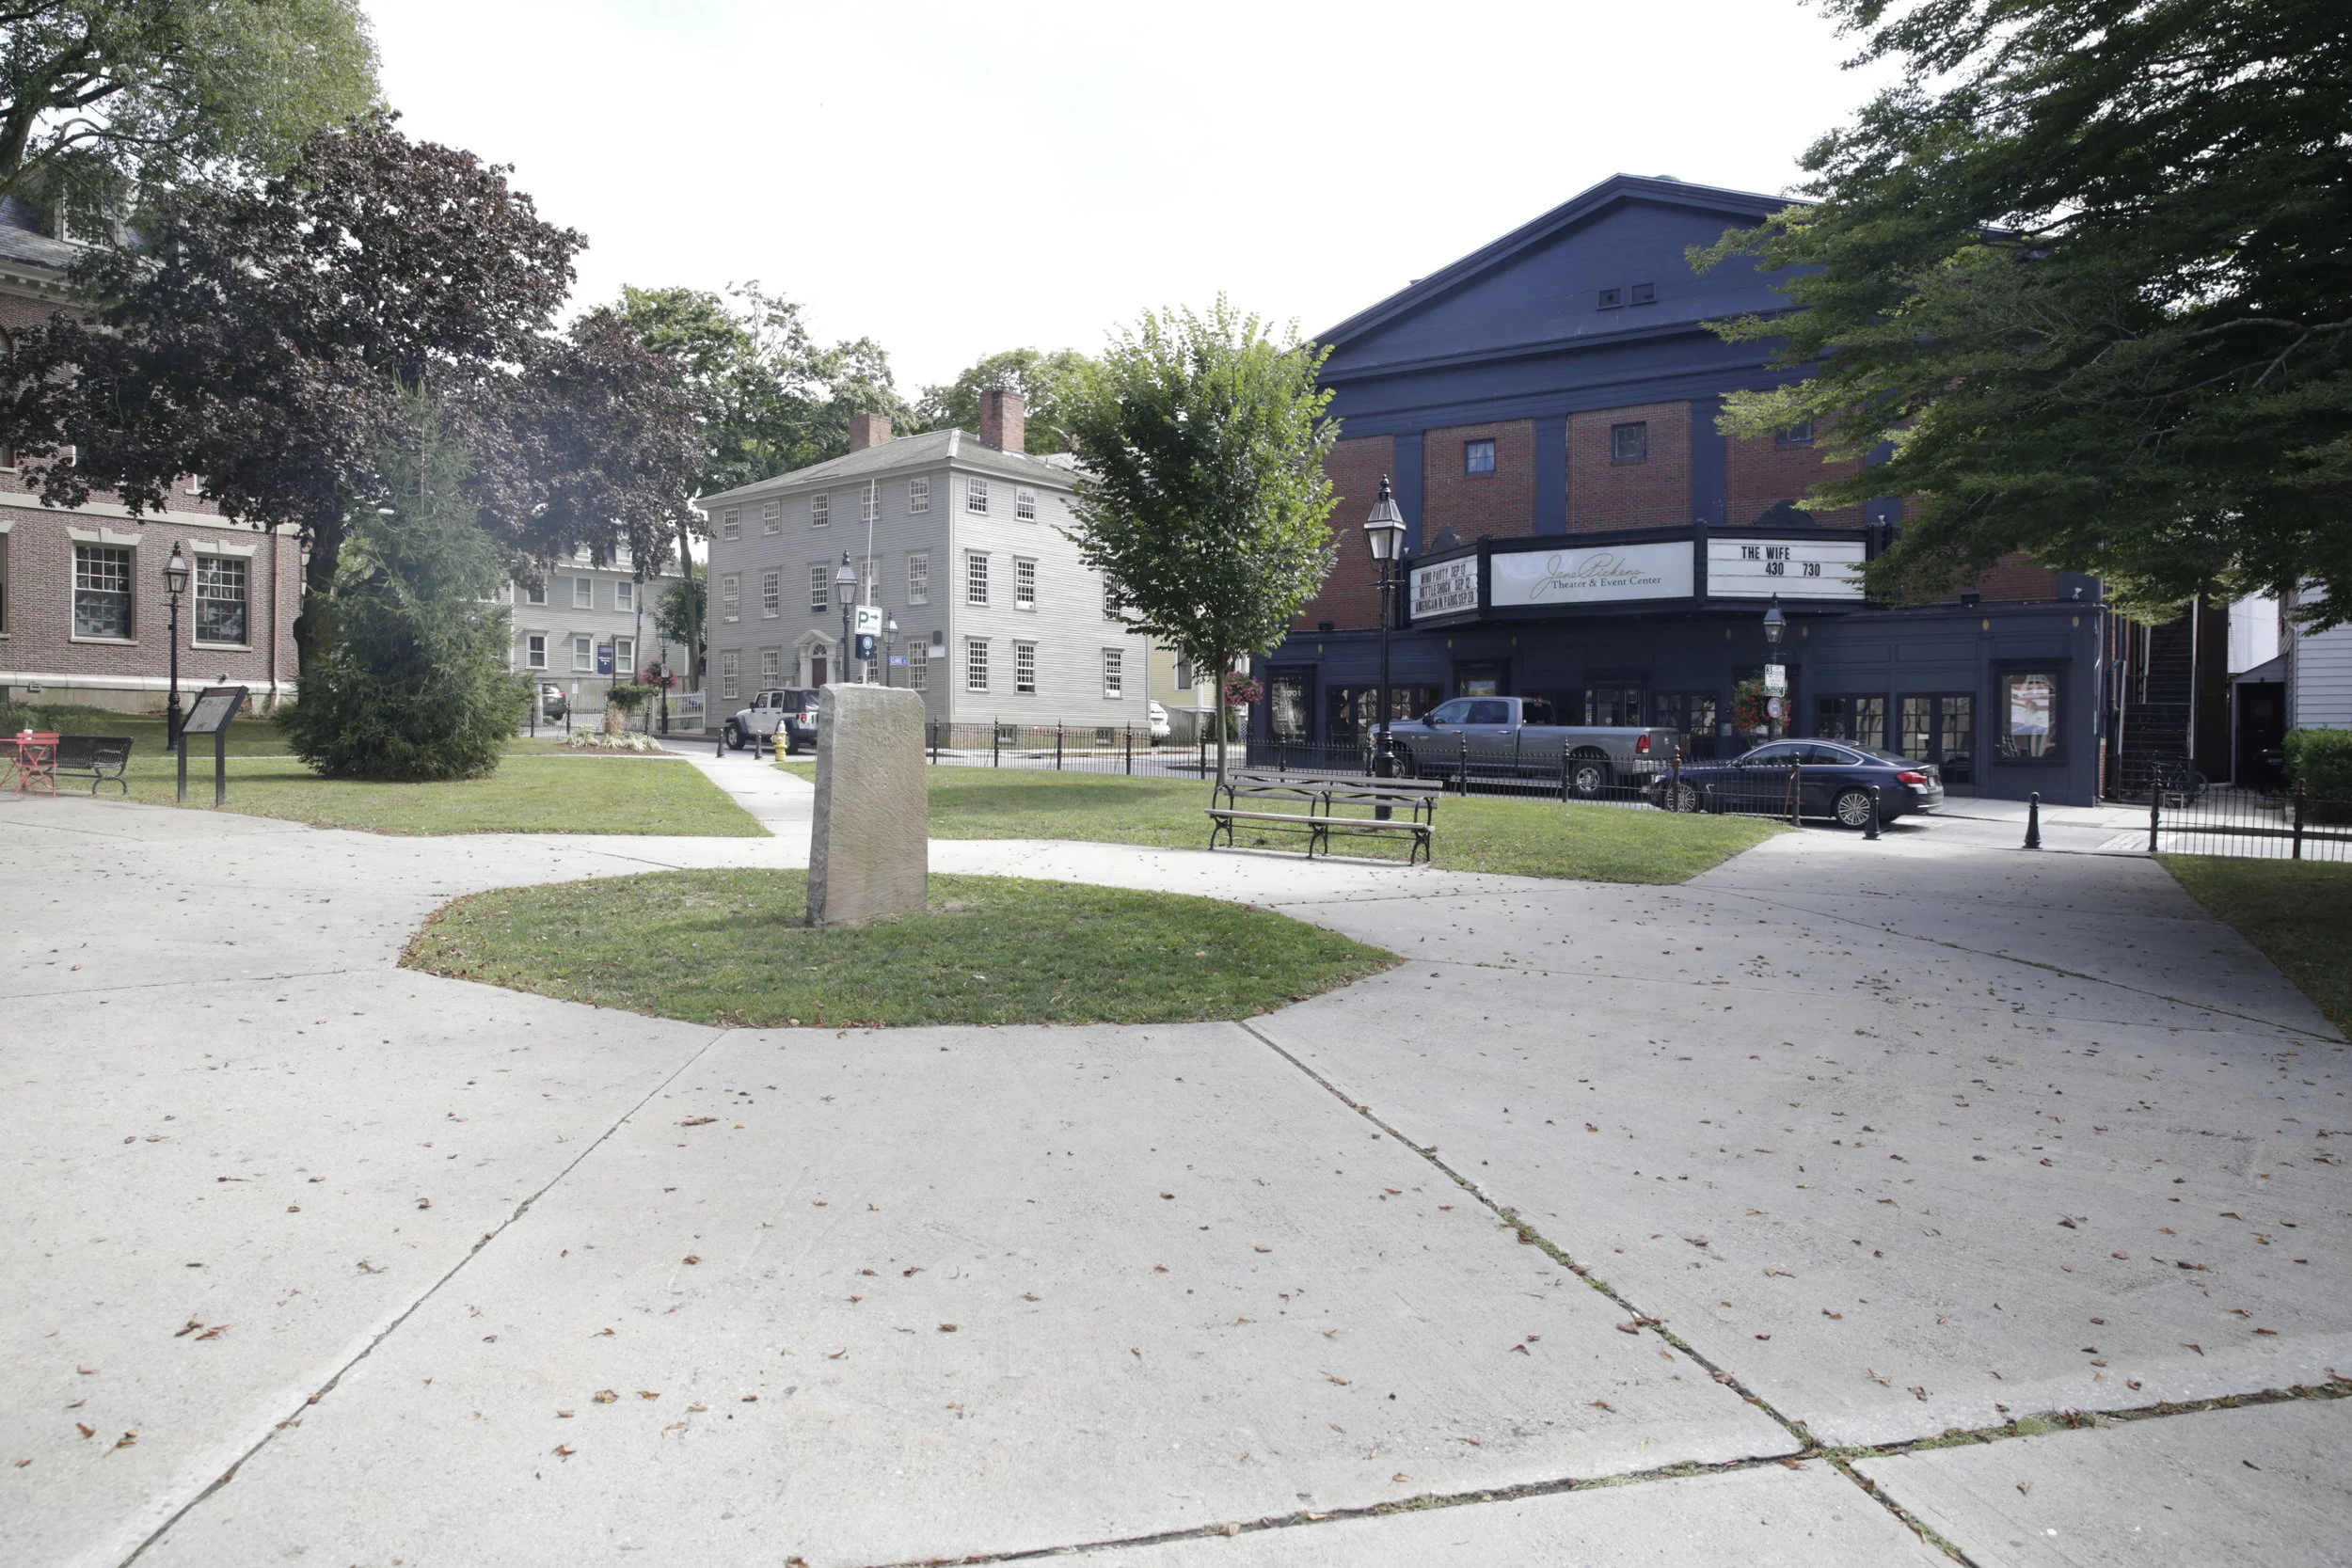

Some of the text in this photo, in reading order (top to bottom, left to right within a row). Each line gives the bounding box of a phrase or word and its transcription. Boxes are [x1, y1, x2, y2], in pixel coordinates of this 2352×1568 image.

[1741, 546, 1790, 560] THE WIFE
[1765, 562, 1820, 577] 430 730
[1530, 554, 1580, 600] Jane
[1551, 576, 1661, 590] Theater & Event Center
